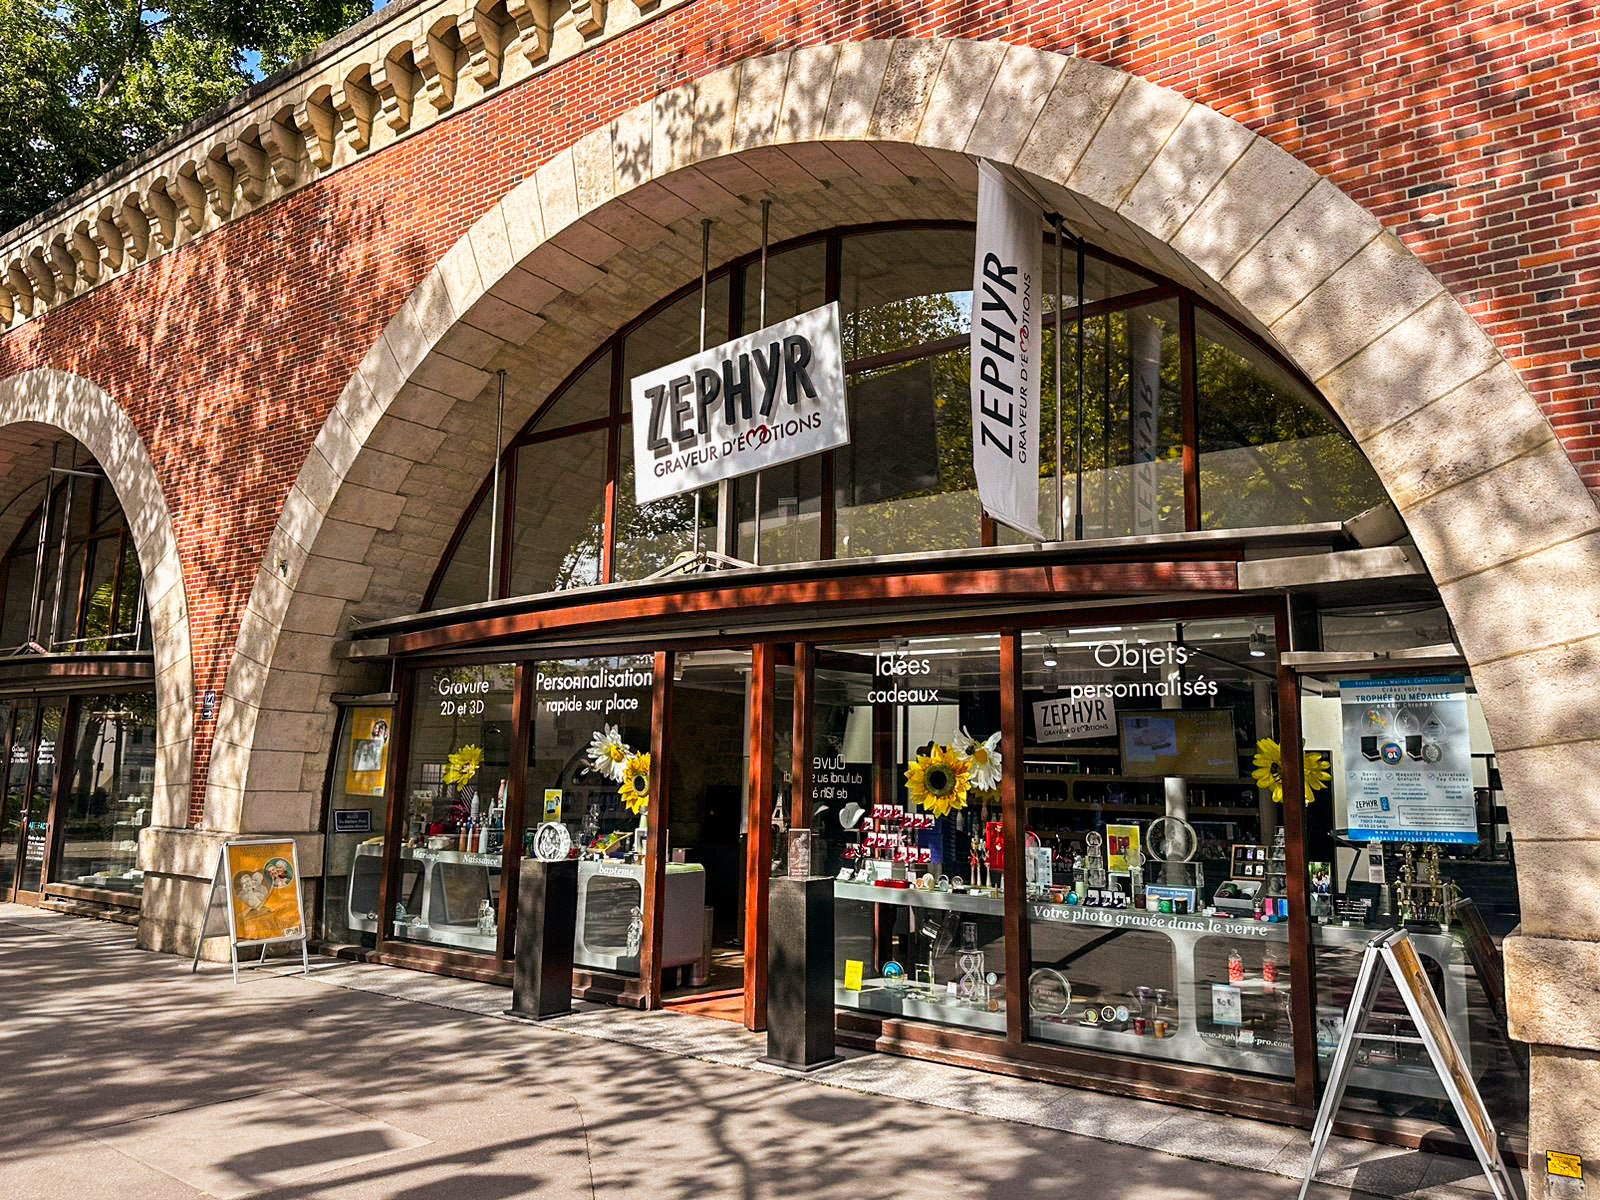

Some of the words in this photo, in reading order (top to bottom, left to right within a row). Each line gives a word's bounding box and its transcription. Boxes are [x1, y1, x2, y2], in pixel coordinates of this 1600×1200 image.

[980, 252, 1018, 460] ZEPHYR
[644, 334, 818, 453] ZEPHYR
[1018, 386, 1028, 464] GRAVEUR
[654, 446, 718, 478] GRAVEUR
[875, 653, 931, 677] Idées
[1094, 639, 1188, 674] Objets
[438, 677, 490, 696] Gravure
[535, 667, 653, 691] Personnalisation
[1070, 675, 1218, 705] personnalisés
[546, 694, 583, 717] rapide
[585, 699, 602, 711] sur
[605, 692, 639, 716] place
[867, 683, 939, 703] cadeaux
[1355, 692, 1393, 702] TROPHÉE
[1395, 692, 1407, 701] OU
[1409, 689, 1450, 700] MÉDAILLE
[440, 700, 455, 716] 2D
[457, 702, 468, 714] et
[469, 699, 485, 714] 3D
[1041, 699, 1108, 728] ZEPHYR
[1043, 728, 1070, 737] GRAVEUR
[1355, 800, 1378, 809] ZEPHYR
[462, 853, 498, 866] Naissance
[1033, 905, 1070, 921] Votre
[1072, 906, 1113, 926] photo
[1115, 912, 1165, 930] gravée
[1168, 916, 1205, 932] dans
[1208, 919, 1222, 933] le
[1224, 922, 1268, 937] verre
